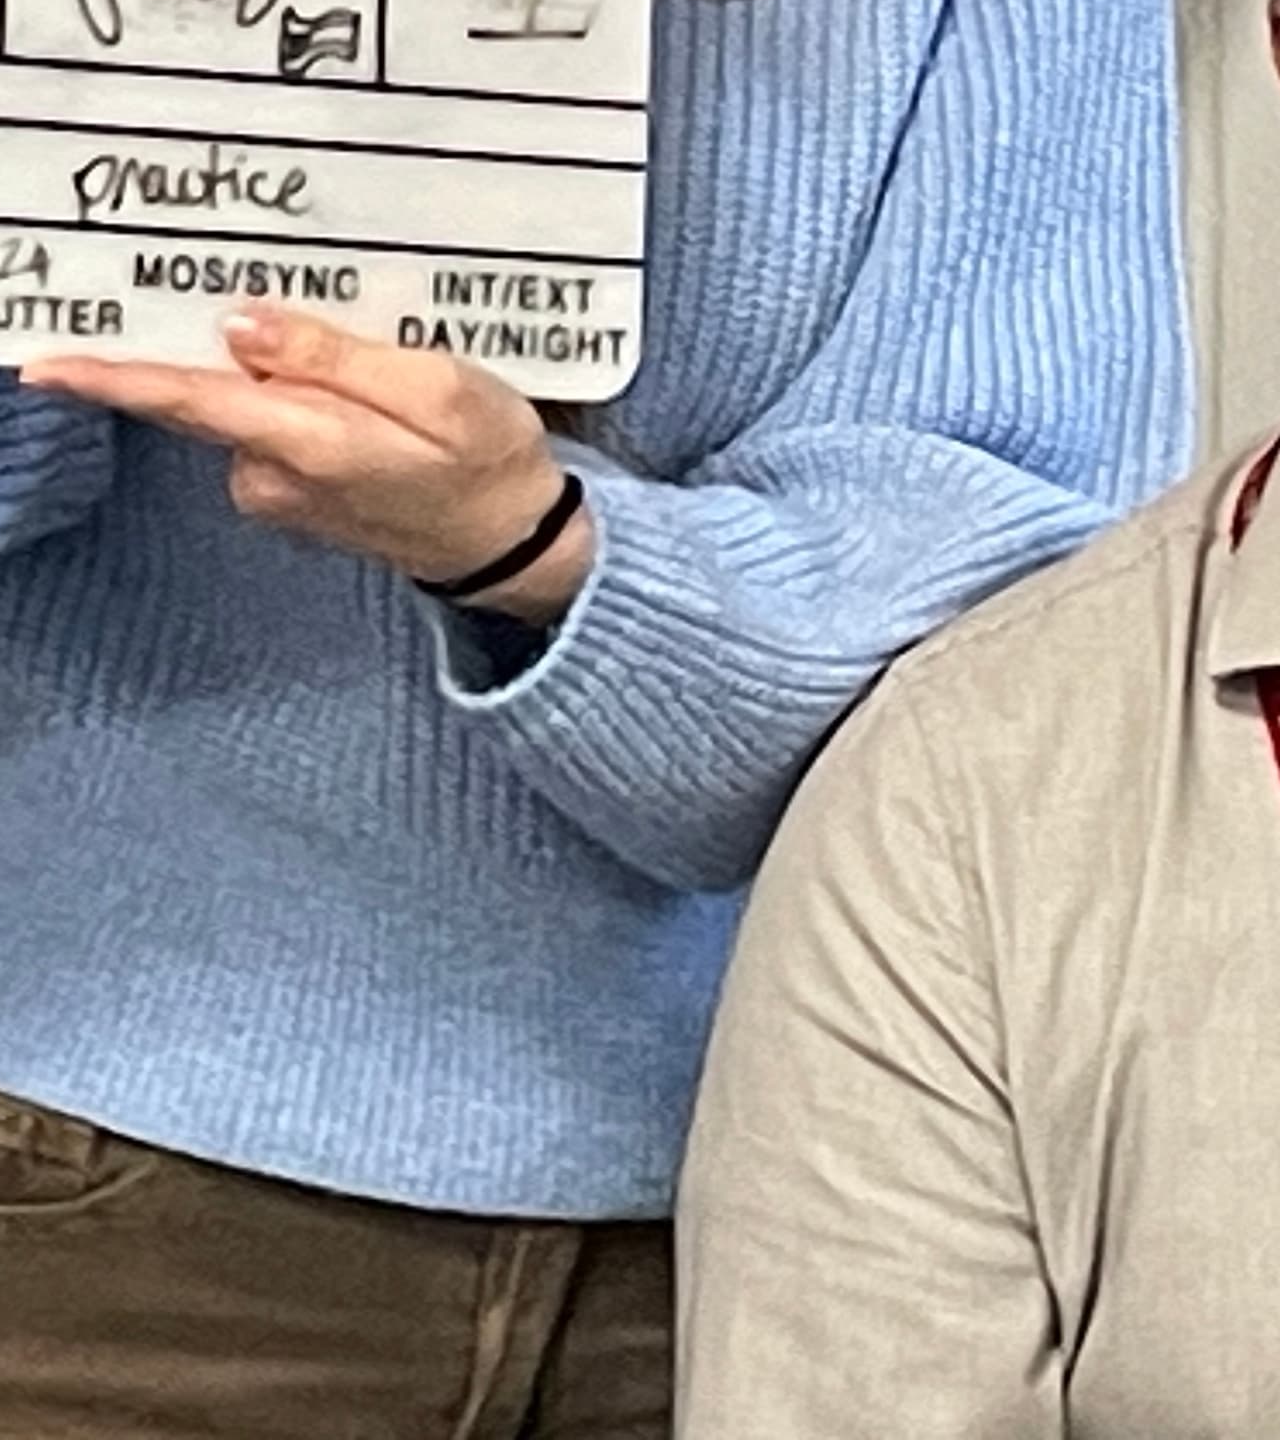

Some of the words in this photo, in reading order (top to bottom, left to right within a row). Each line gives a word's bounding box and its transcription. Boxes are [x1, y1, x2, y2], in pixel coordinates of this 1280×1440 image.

[74, 145, 312, 222] practice
[133, 253, 361, 302] MOS/SYNC
[431, 270, 596, 313] INT/EXT
[398, 316, 628, 366] DAY/NIGHT
